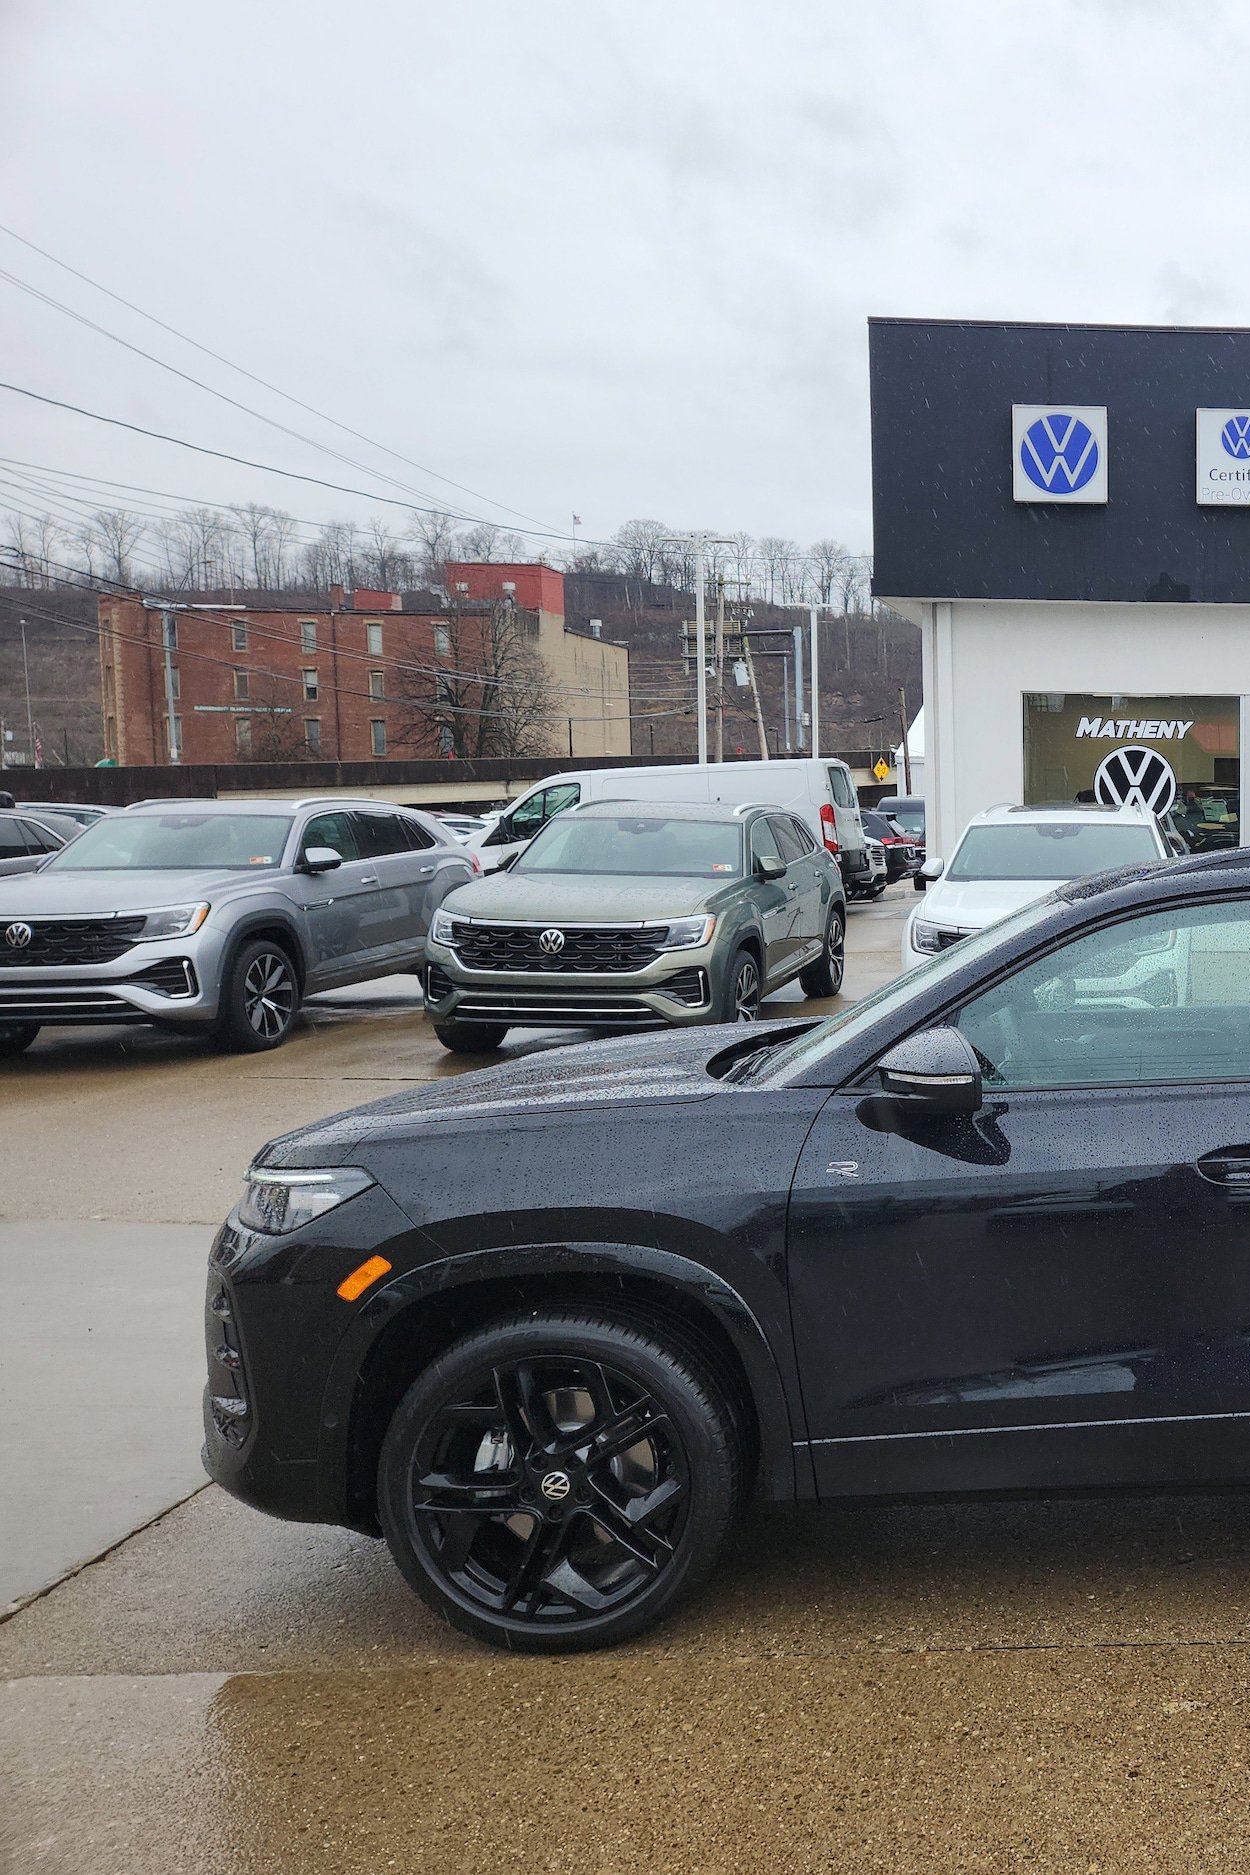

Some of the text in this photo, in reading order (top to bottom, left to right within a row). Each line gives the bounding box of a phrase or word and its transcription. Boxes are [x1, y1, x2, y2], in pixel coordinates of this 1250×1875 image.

[1021, 414, 1099, 494] VW
[1075, 716, 1195, 740] MATHENY
[6, 922, 31, 948] VW
[539, 928, 565, 954] VW
